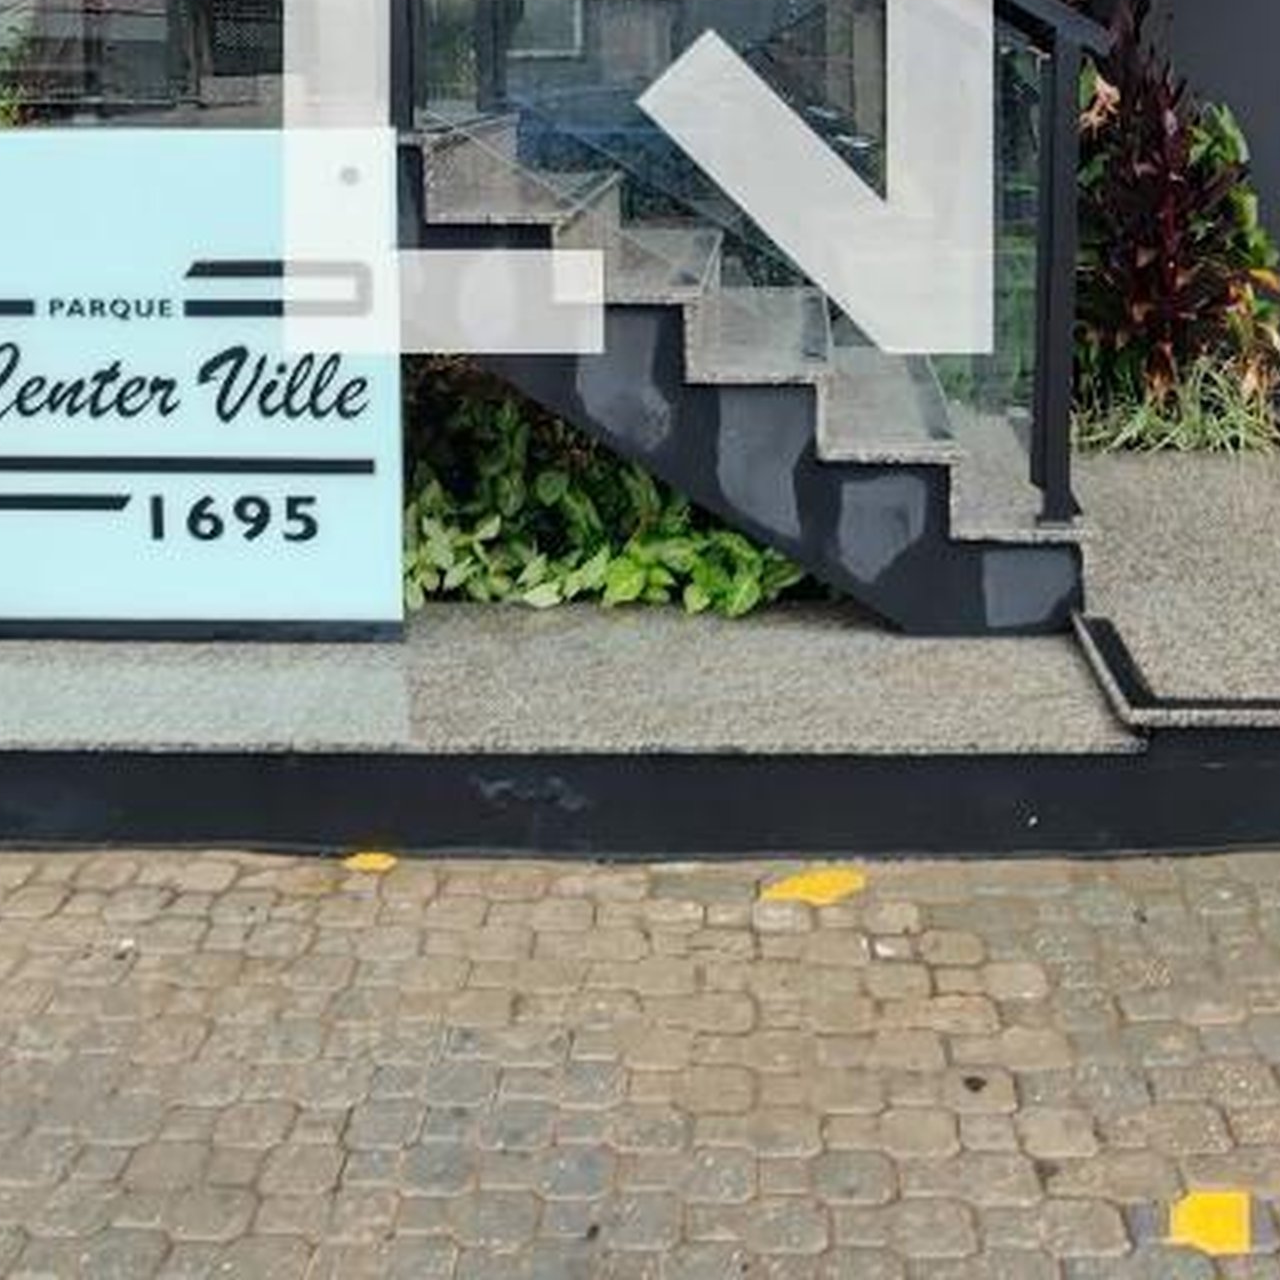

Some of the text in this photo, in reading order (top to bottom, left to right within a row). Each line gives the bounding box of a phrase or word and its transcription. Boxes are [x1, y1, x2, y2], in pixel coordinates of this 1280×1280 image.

[48, 297, 173, 321] PARQUE
[197, 345, 370, 424] Ville
[149, 494, 320, 542] 1695
